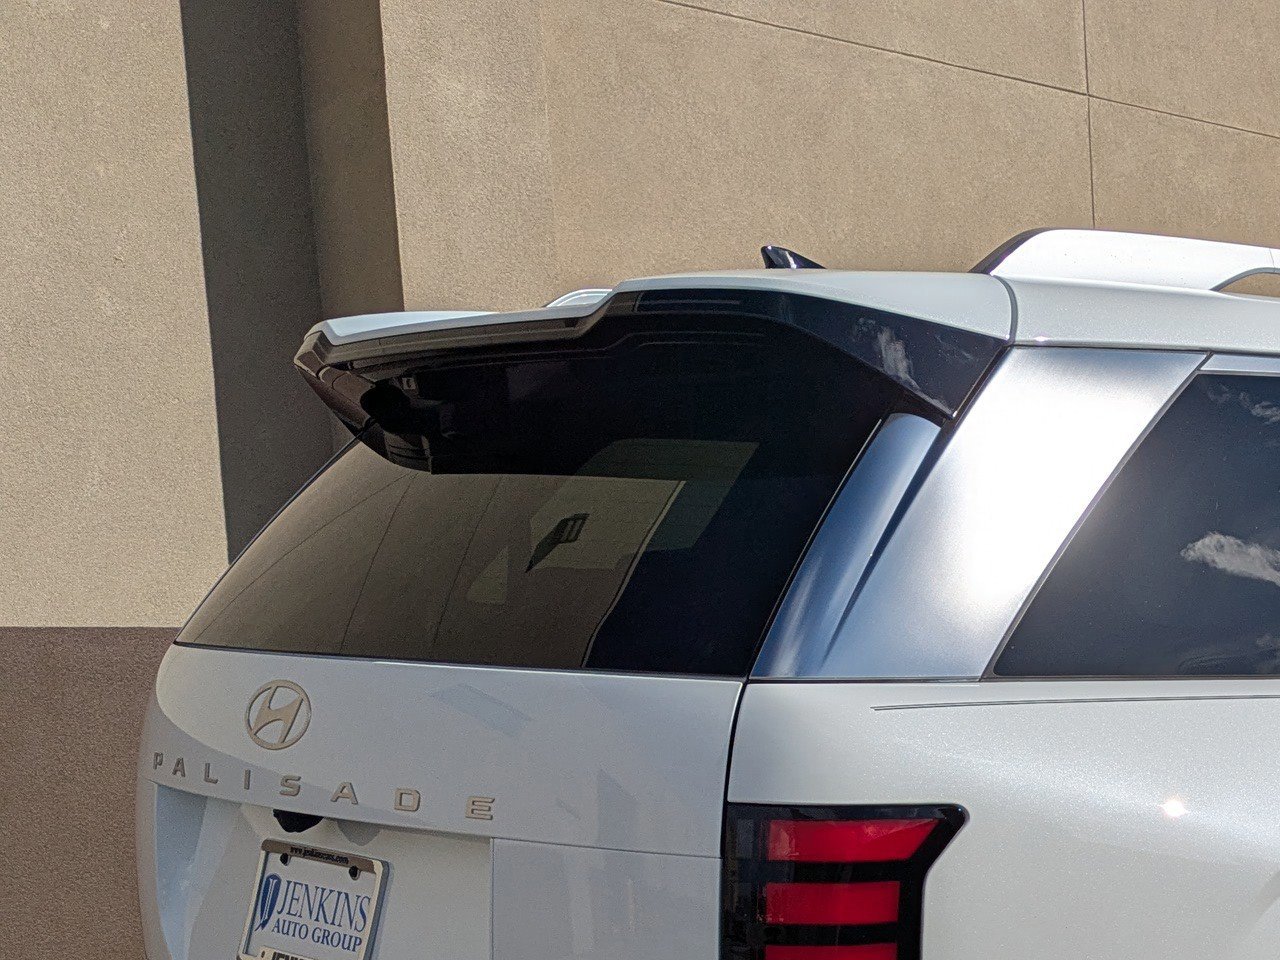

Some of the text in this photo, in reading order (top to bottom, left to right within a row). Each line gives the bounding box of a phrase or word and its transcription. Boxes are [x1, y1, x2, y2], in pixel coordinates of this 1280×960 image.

[152, 752, 496, 821] PALISADE
[276, 879, 372, 933] JENKINS
[271, 917, 363, 952] AUTO GROUP
